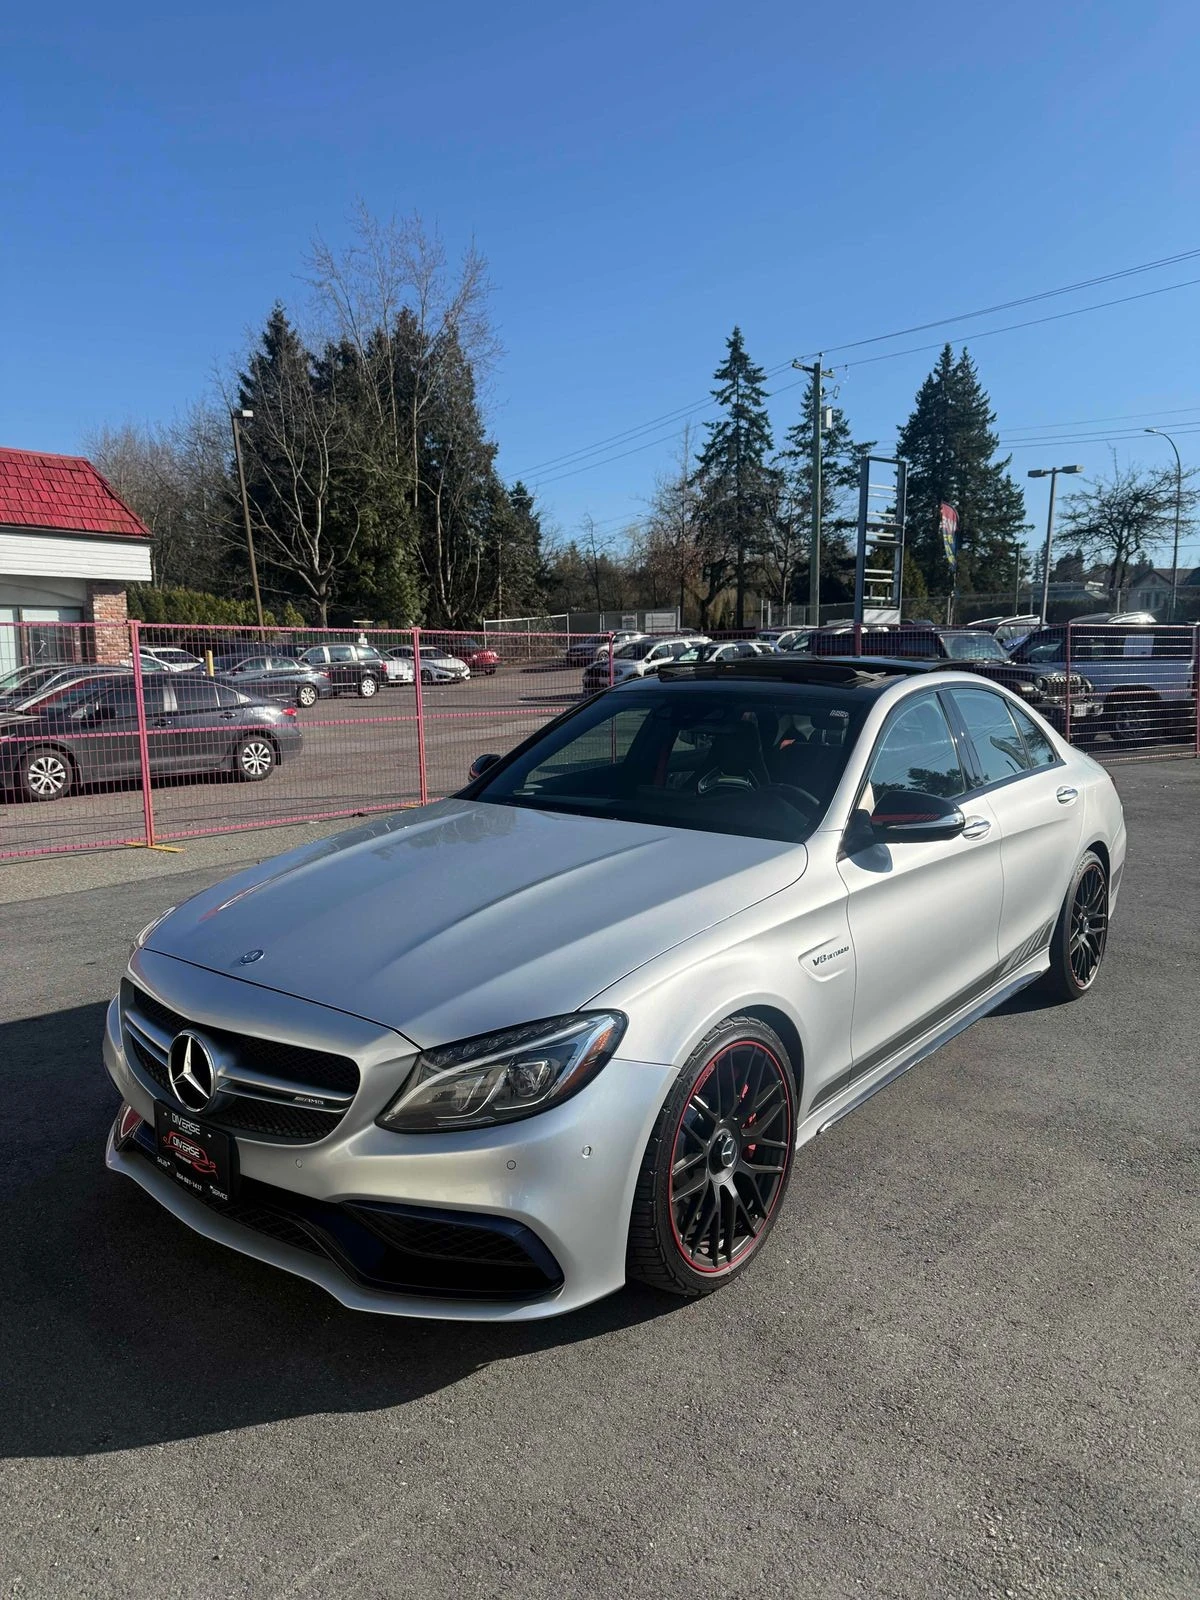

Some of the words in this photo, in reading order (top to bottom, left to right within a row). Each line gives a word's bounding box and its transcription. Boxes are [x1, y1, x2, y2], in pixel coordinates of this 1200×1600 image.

[812, 954, 827, 966] V8
[301, 1097, 324, 1105] AMG
[172, 1113, 200, 1135] DIVERSE
[172, 1136, 200, 1158] DIVERSE
[212, 1188, 228, 1200] SERVICE
